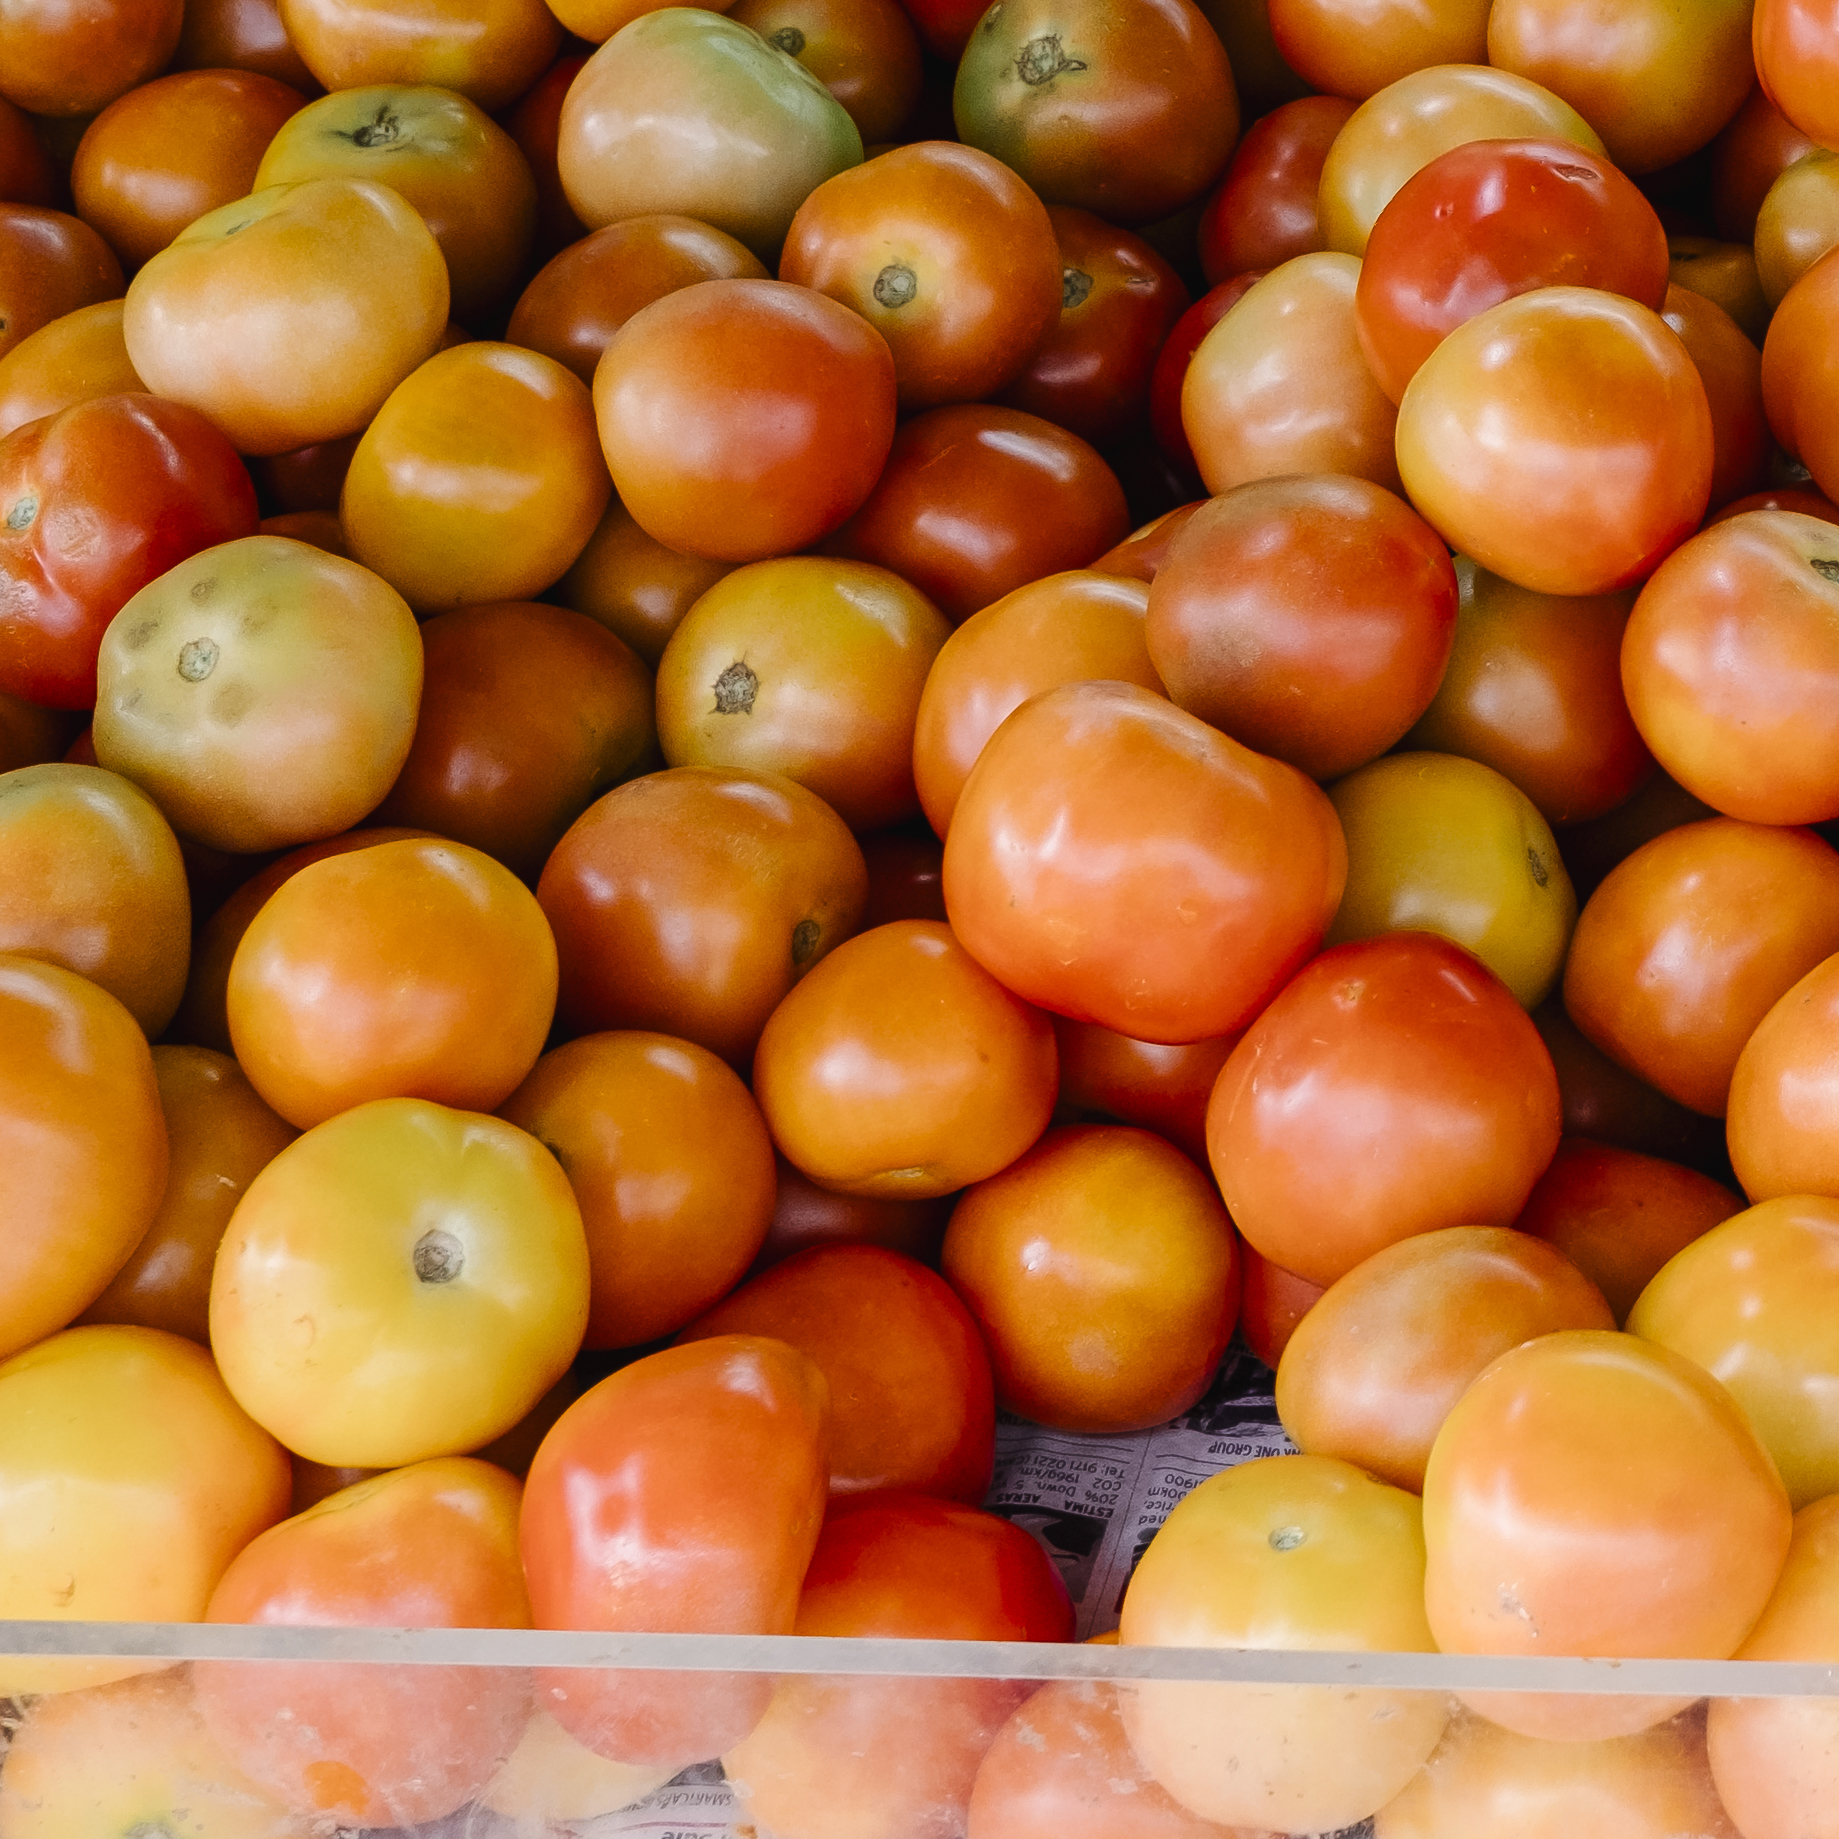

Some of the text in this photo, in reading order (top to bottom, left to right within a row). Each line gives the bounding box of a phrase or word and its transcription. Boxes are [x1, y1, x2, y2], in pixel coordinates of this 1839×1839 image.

[1208, 1441, 1253, 1456] GROUP
[1034, 1455, 1067, 1469] 0221
[1070, 1460, 1098, 1473] 9171
[1015, 1479, 1024, 1490] 5
[1092, 1477, 1122, 1491] CO2
[1164, 1473, 1202, 1488] 1900
[1085, 1490, 1119, 1505] 20%
[996, 1492, 1115, 1518] ESTIMA AERAS
[1143, 1501, 1175, 1511] rice,
